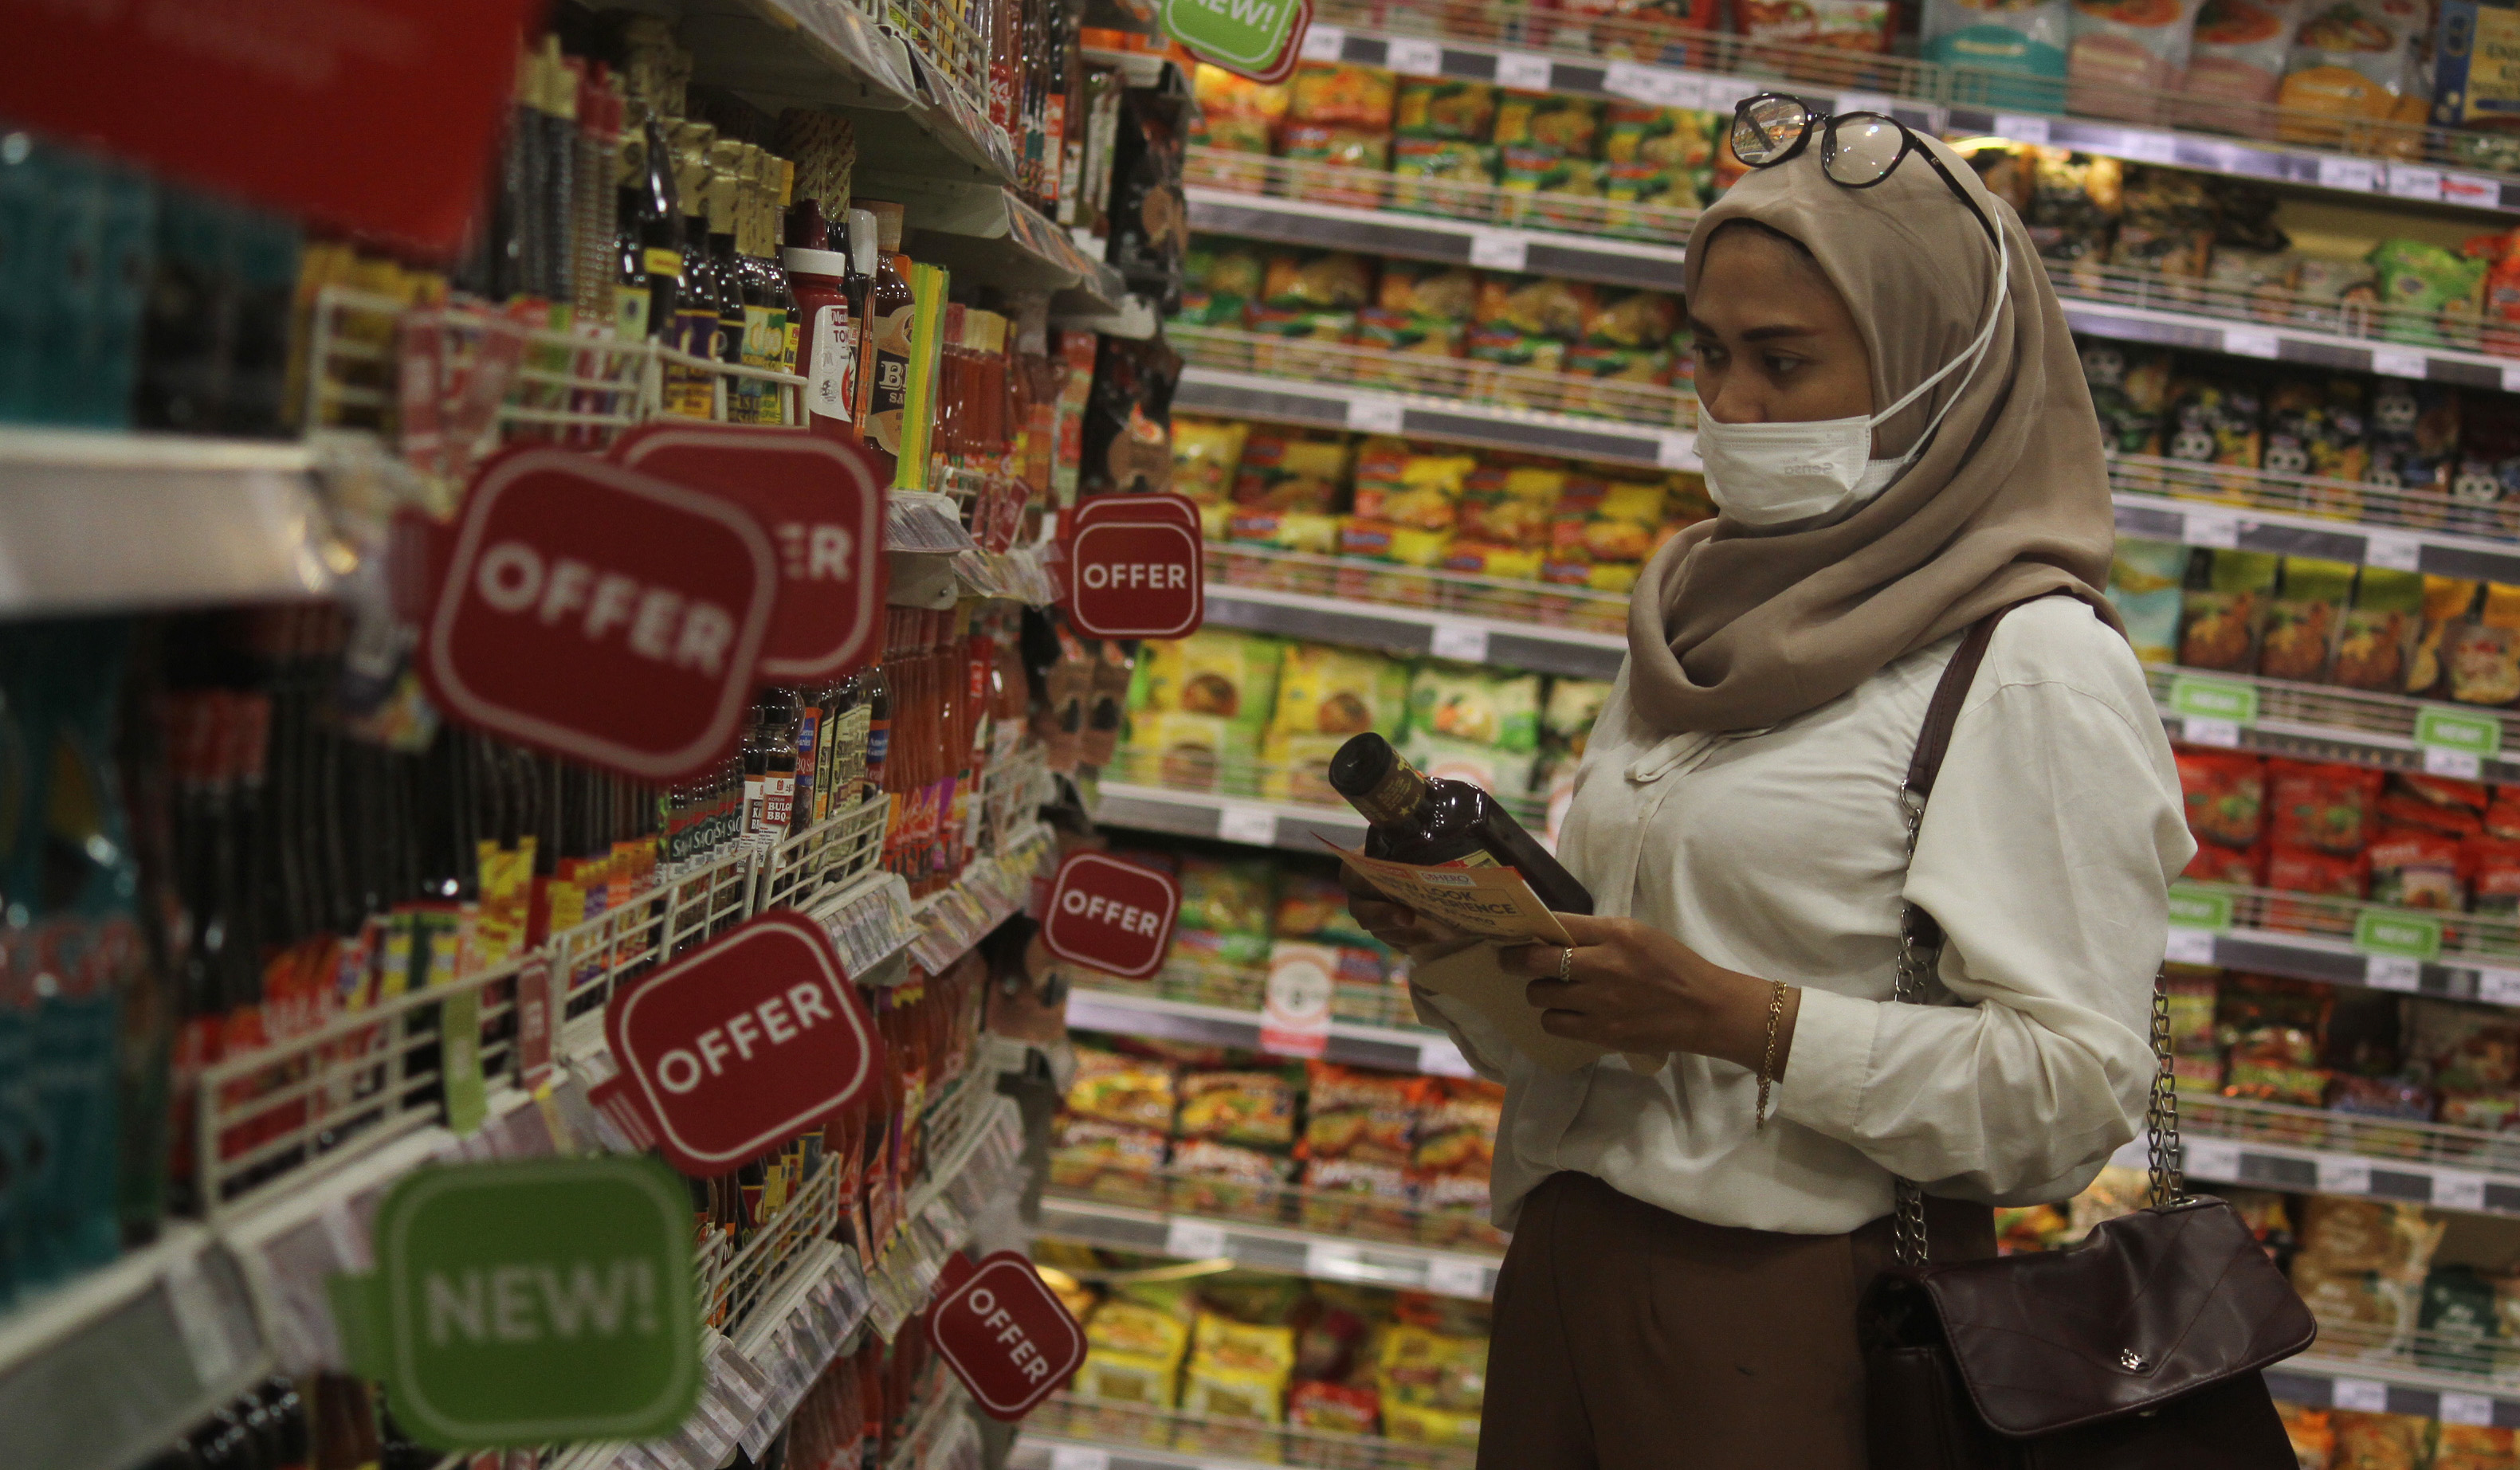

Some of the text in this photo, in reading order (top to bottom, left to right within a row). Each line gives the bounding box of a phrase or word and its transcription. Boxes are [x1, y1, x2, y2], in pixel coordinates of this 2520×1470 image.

[1186, 0, 1277, 32] EW!
[476, 540, 737, 677] OFFER
[1083, 562, 1187, 590] OFFER
[767, 811, 787, 822] BBQ
[1062, 888, 1160, 939] OFFER
[656, 981, 833, 1094] OFFER
[424, 1256, 657, 1350] NEW!
[968, 1287, 1050, 1385] OFFER
